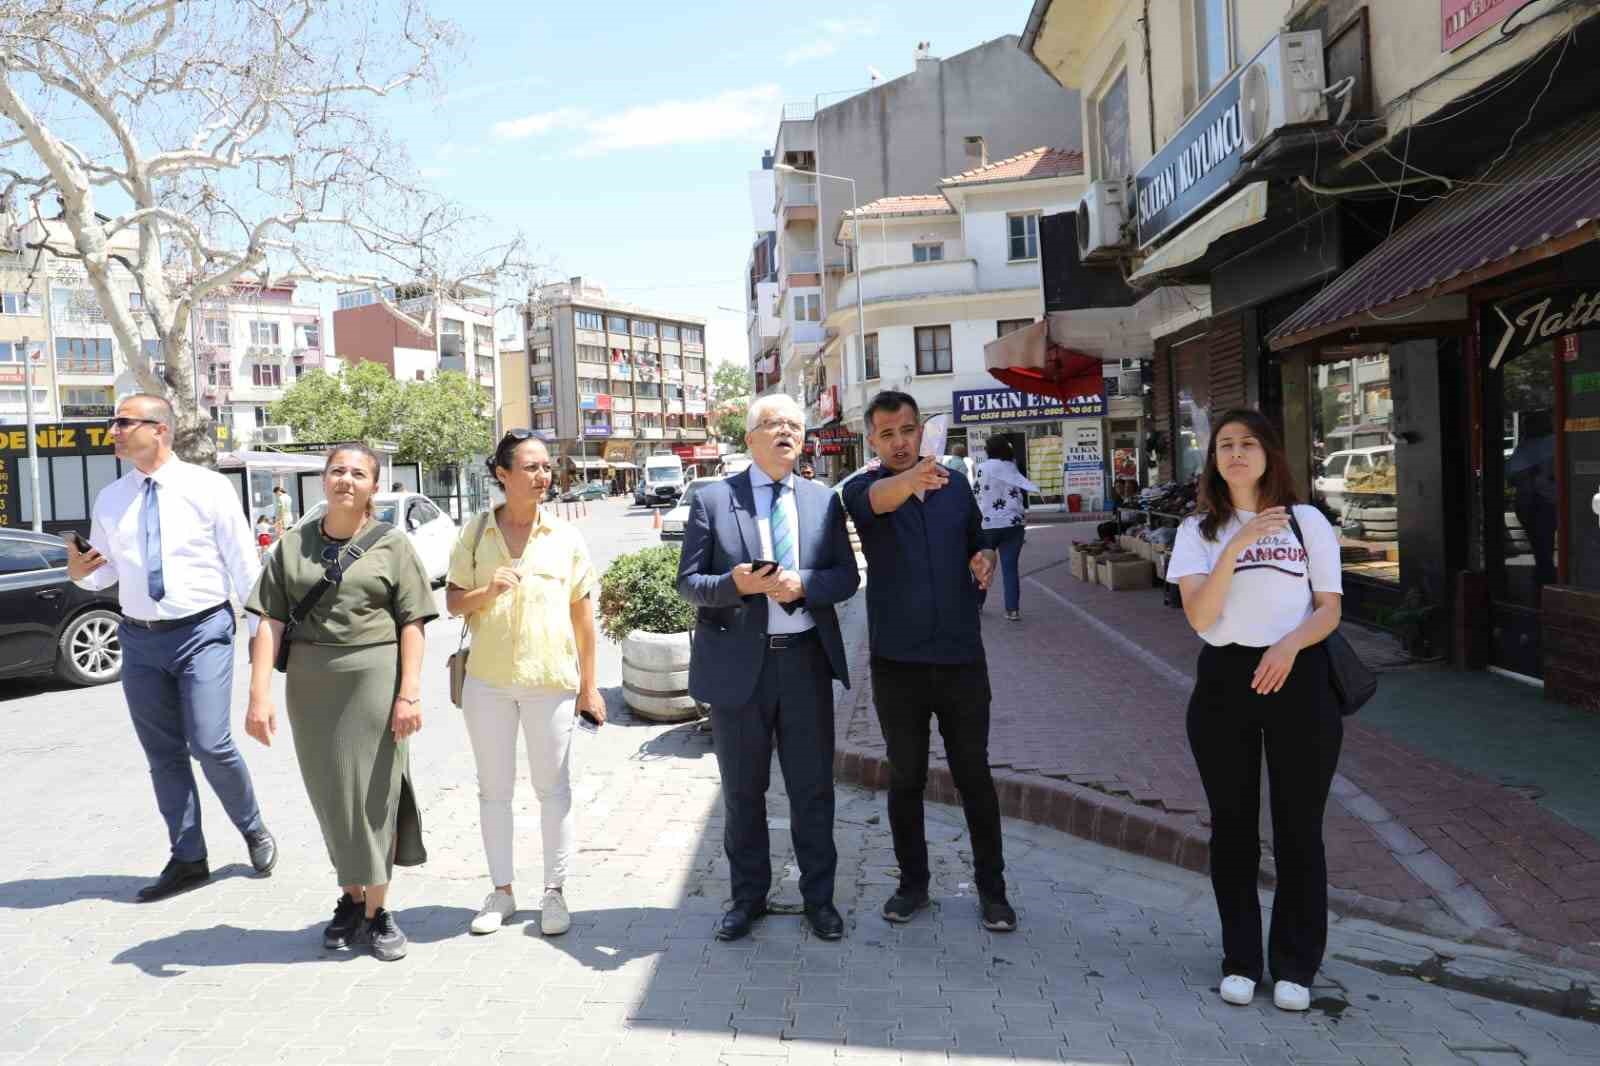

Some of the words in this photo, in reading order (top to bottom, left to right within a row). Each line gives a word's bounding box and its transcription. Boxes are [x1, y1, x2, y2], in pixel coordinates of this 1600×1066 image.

[1139, 162, 1177, 225] SULTAN
[1178, 99, 1243, 193] KUYUMCU
[85, 427, 116, 446] TA
